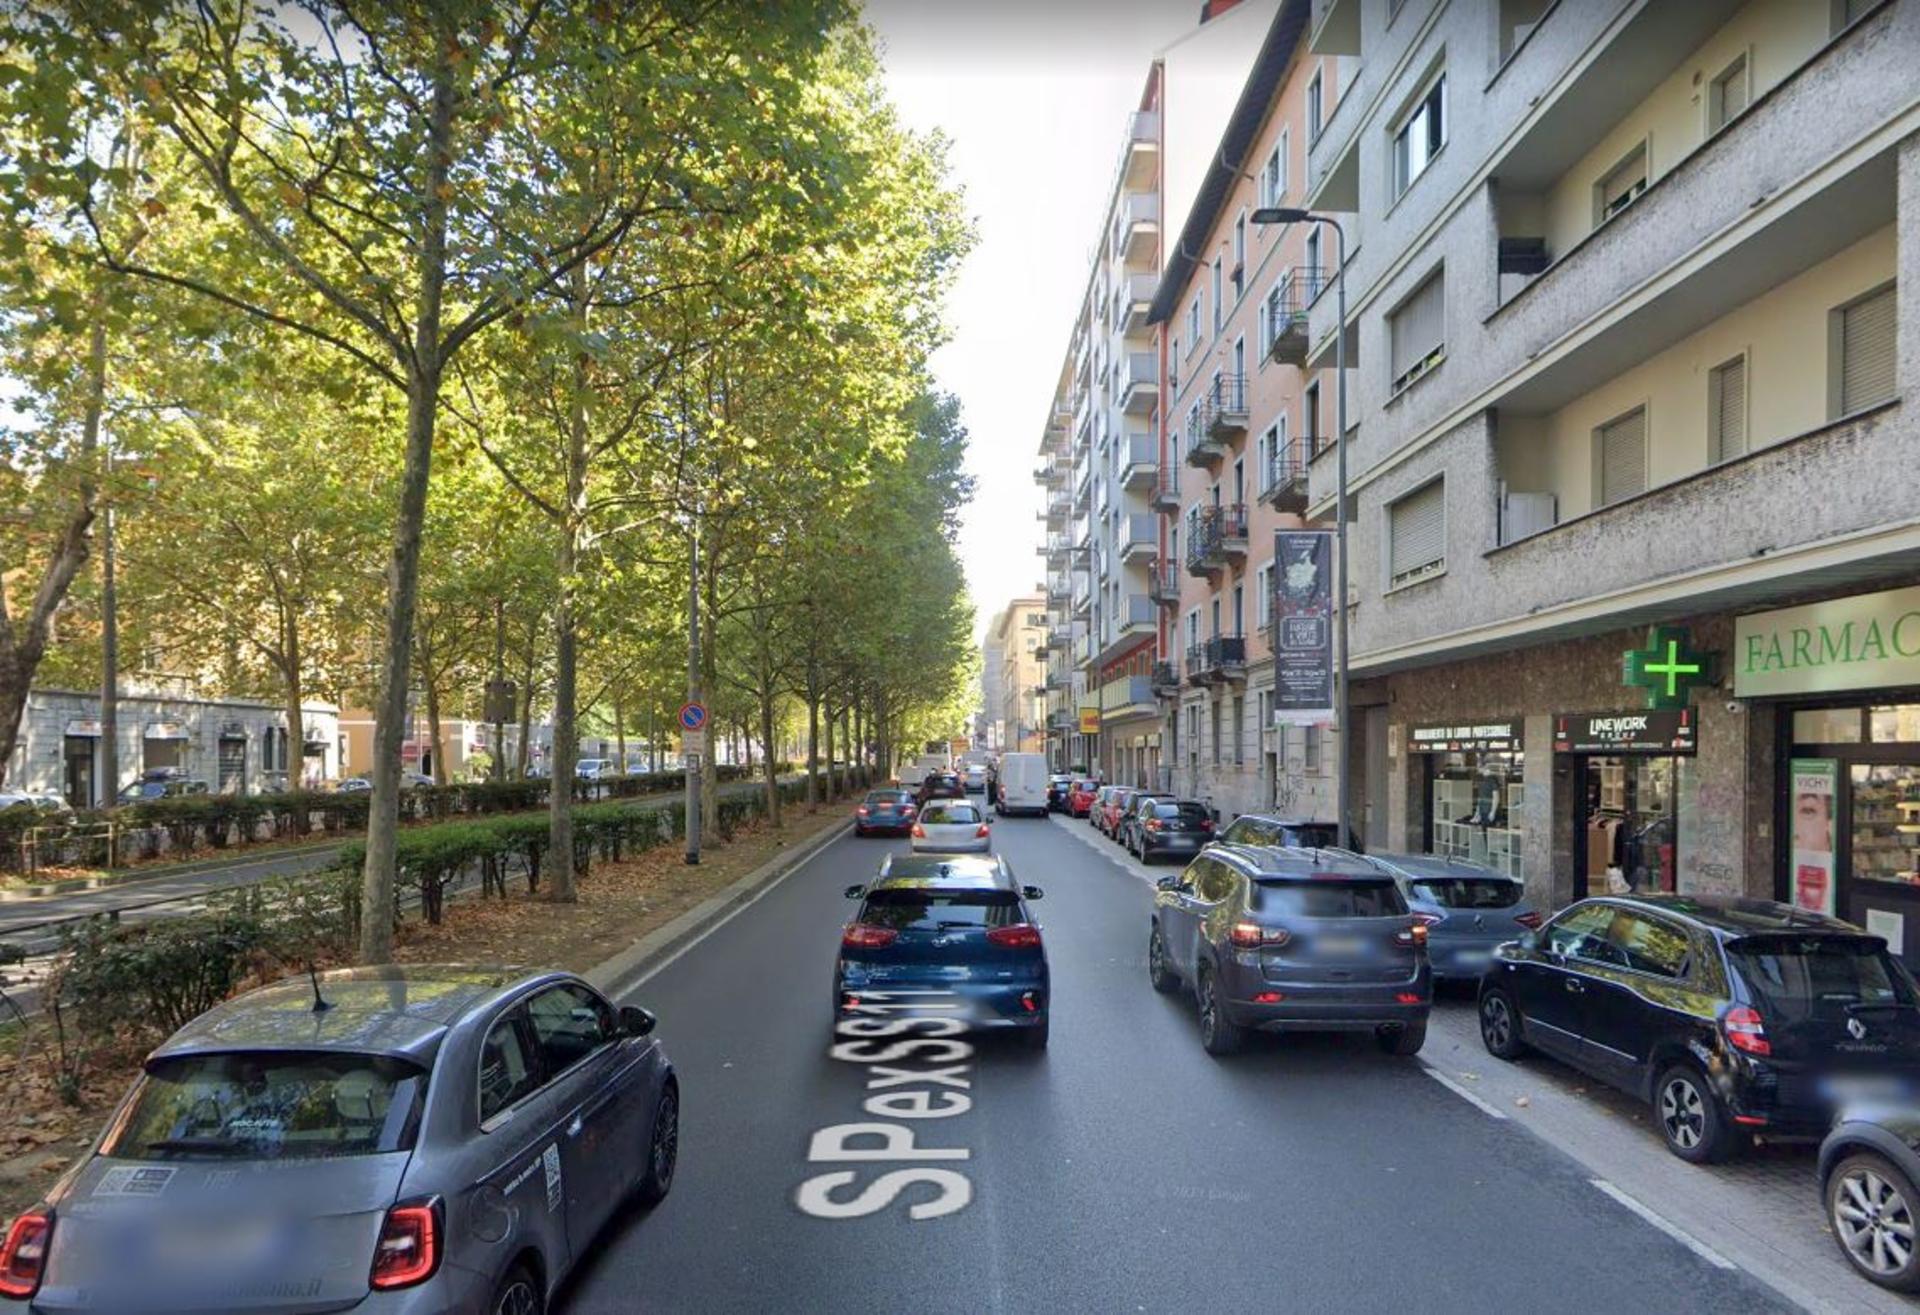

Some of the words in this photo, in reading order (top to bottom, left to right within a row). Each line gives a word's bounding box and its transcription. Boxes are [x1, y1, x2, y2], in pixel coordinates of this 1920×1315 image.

[1745, 611, 1920, 672] FARMAC
[1590, 716, 1648, 735] LINEWORK
[1797, 776, 1829, 788] VICHY
